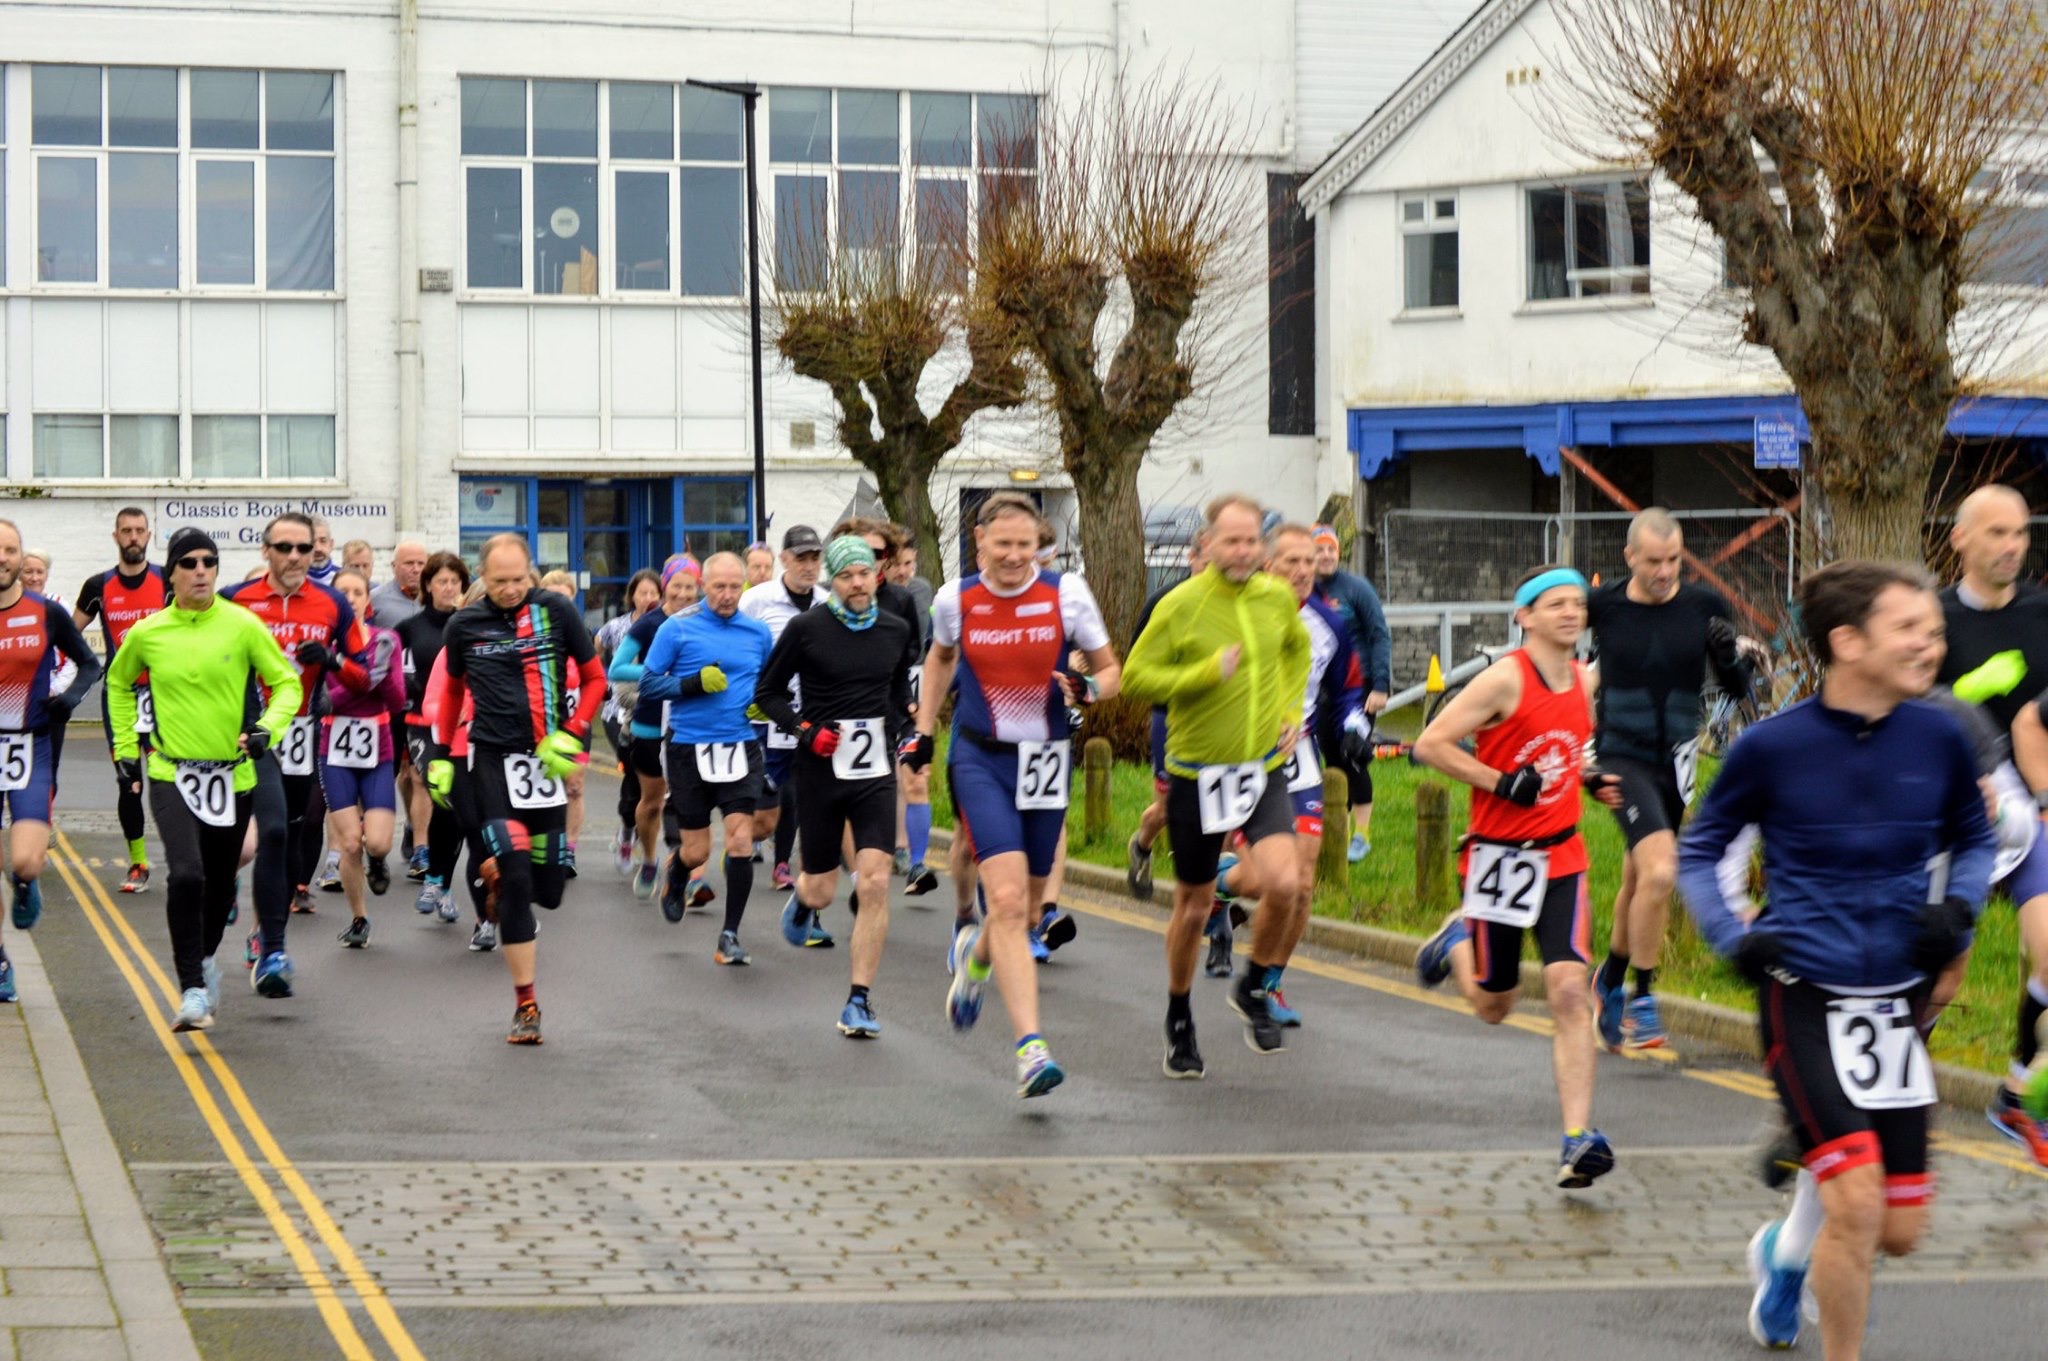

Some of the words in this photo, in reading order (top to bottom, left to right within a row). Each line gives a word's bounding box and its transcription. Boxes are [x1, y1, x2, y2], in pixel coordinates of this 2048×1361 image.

[165, 501, 238, 518] Classic
[246, 501, 292, 518] Boat
[302, 501, 387, 517] Museum
[107, 609, 142, 621] WIGHT
[300, 624, 328, 640] TRI
[16, 634, 40, 648] TRI
[968, 627, 1024, 645] WIGHT
[1026, 624, 1056, 643] TRI
[335, 726, 374, 760] 43
[702, 742, 738, 775] 17
[848, 729, 873, 770] 2
[512, 760, 557, 800] 33
[1022, 751, 1061, 797] 52
[181, 773, 226, 816] 30
[1207, 773, 1257, 820] 15
[1476, 857, 1535, 910] 42
[1843, 1015, 1920, 1091] 37
